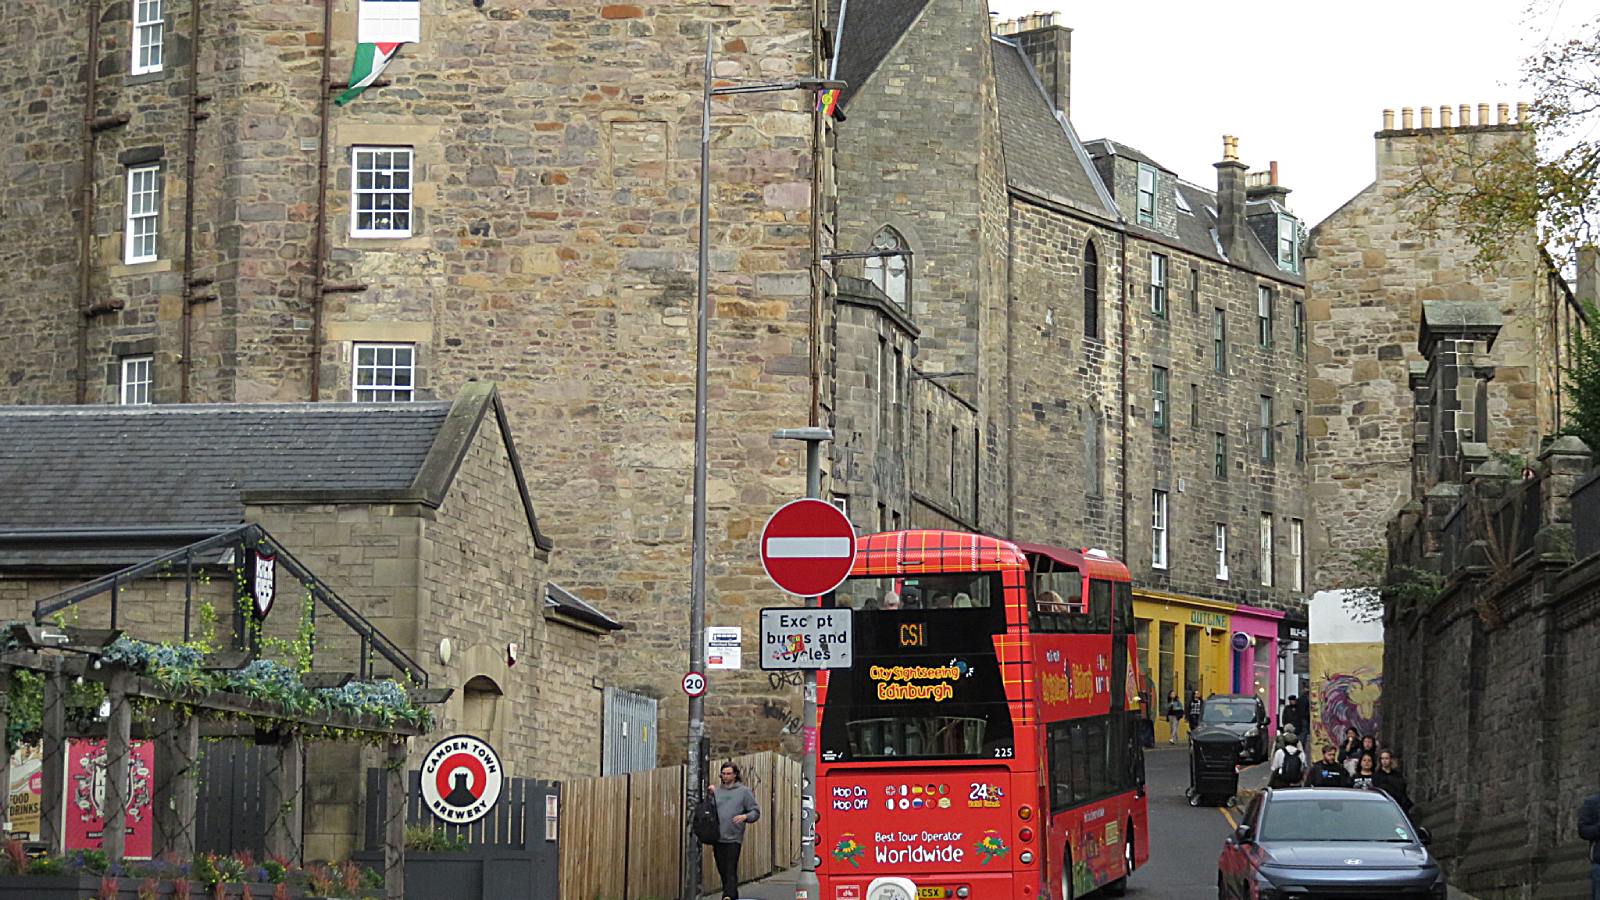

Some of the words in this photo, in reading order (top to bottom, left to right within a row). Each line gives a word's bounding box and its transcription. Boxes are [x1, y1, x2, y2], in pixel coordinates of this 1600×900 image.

[780, 615, 833, 629] Excpt
[819, 630, 847, 644] and
[686, 679, 703, 690] 20
[877, 681, 953, 702] Edinburgh
[427, 742, 469, 774] CAMDEN
[472, 744, 497, 774] TOWN
[994, 747, 1013, 758] 225
[833, 787, 852, 798] Hop
[854, 785, 867, 797] On
[969, 783, 988, 800] 24
[10, 803, 39, 816] DRINKS
[433, 800, 488, 819] BREWERY
[833, 800, 852, 811] Hop
[854, 798, 869, 810] Off
[875, 832, 896, 842] Best
[898, 831, 918, 842] Tour
[921, 830, 963, 843] Operator
[875, 845, 964, 864] Worldwide
[922, 889, 939, 897] CSX
